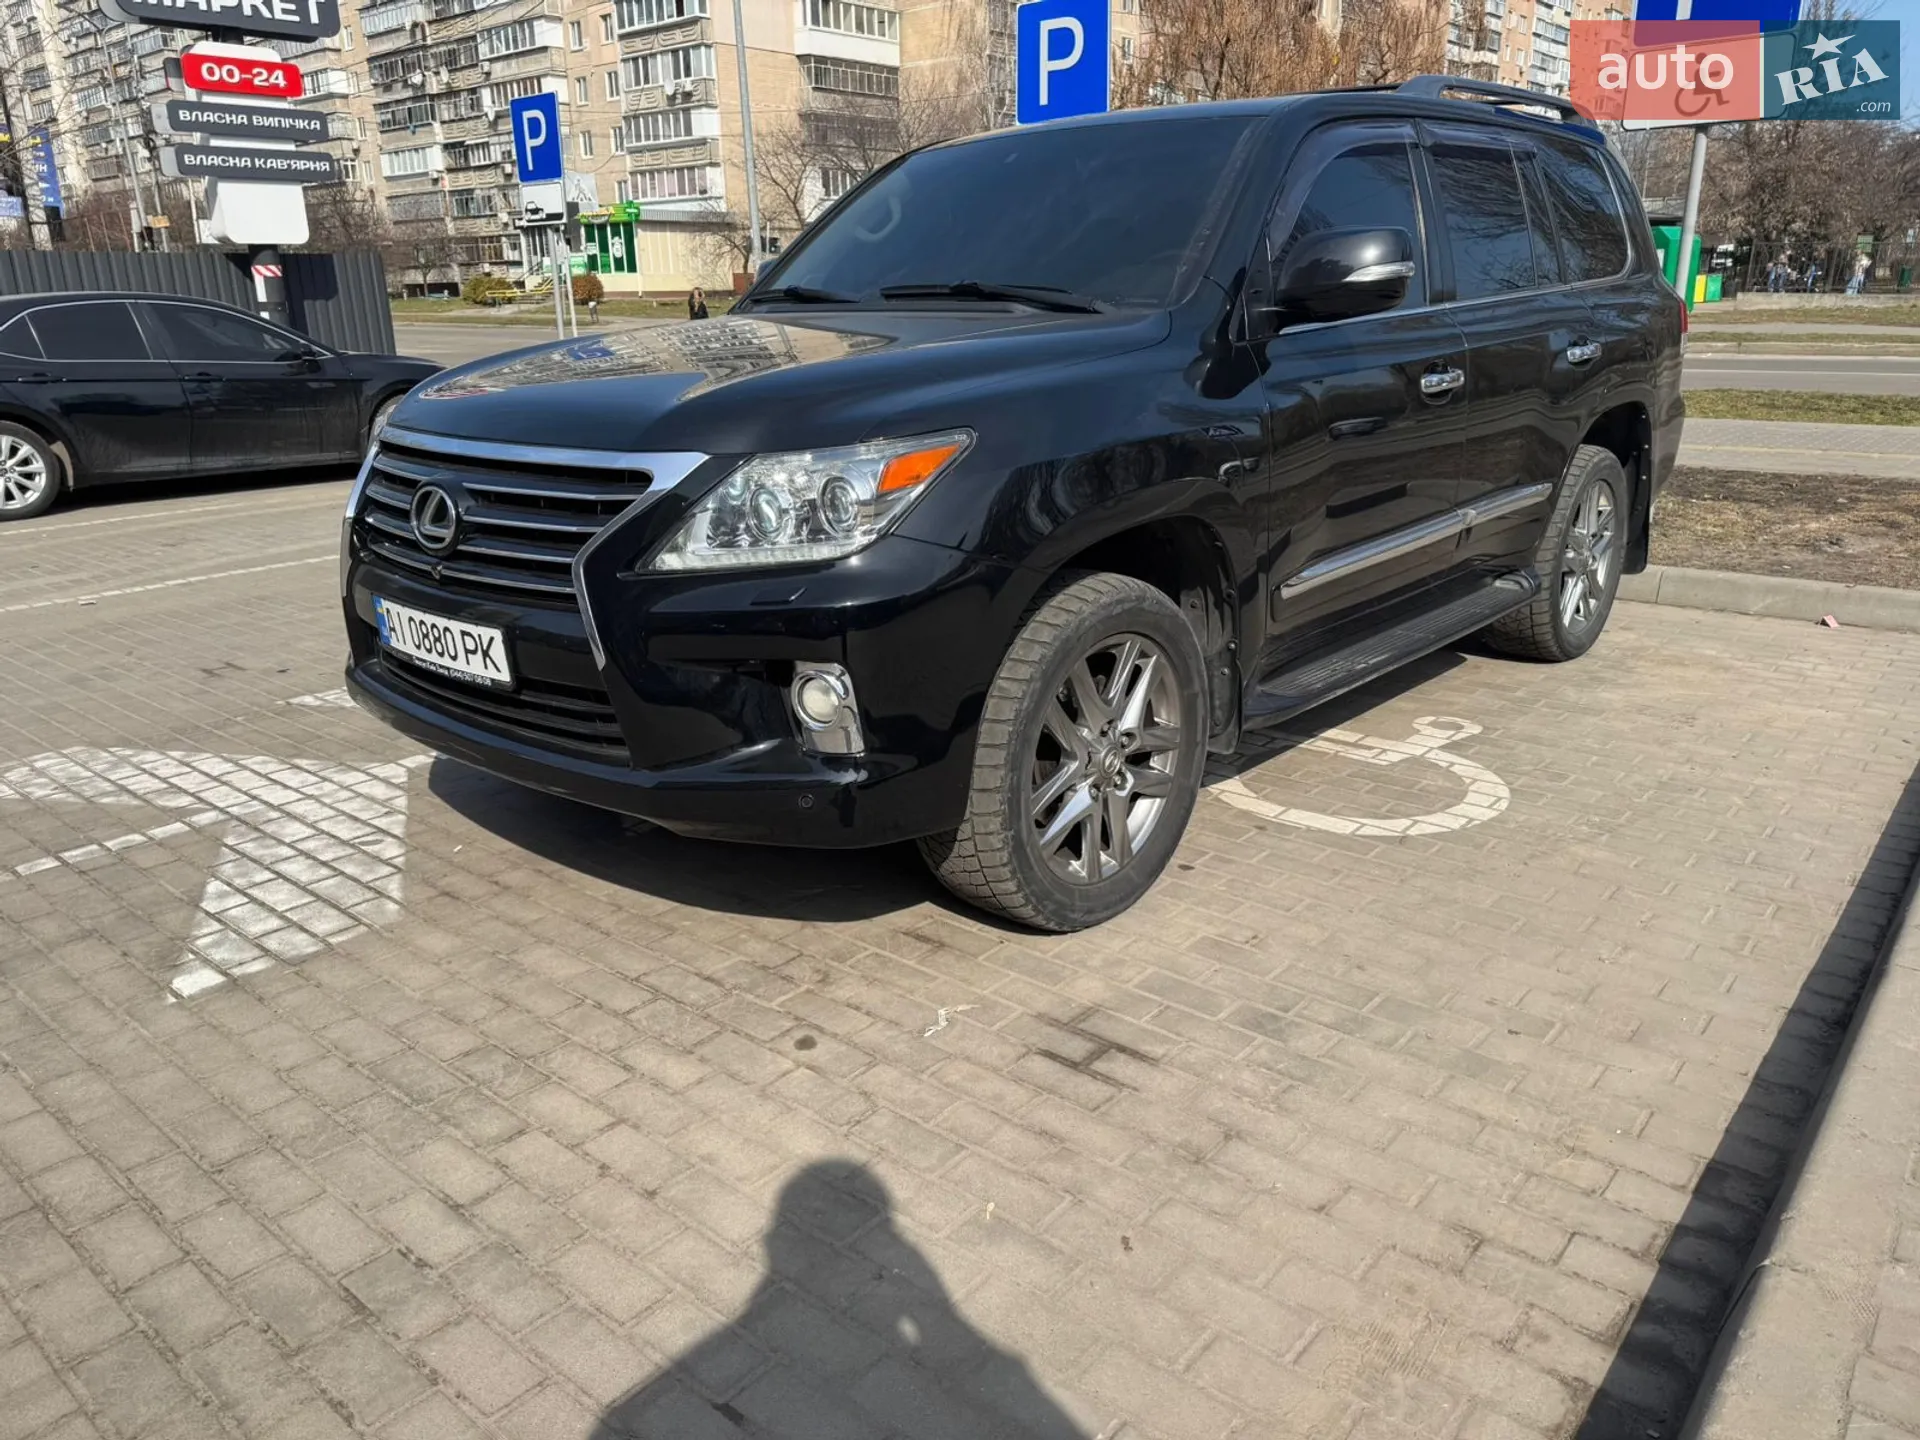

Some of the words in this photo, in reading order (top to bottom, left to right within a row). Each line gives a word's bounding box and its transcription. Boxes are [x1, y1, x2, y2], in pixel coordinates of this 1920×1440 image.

[132, 0, 326, 25] КЕТ
[1039, 16, 1085, 107] P
[200, 62, 288, 89] 00-24
[178, 109, 248, 125] ВЛАСНА
[252, 115, 321, 131] ВИПІЧКА
[522, 109, 547, 171] P
[183, 153, 251, 168] ВЛАСНА
[254, 157, 330, 172] КАВ'ЯРНЯ
[385, 607, 407, 646] AI
[408, 615, 458, 662] 0880
[460, 629, 502, 673] PK
